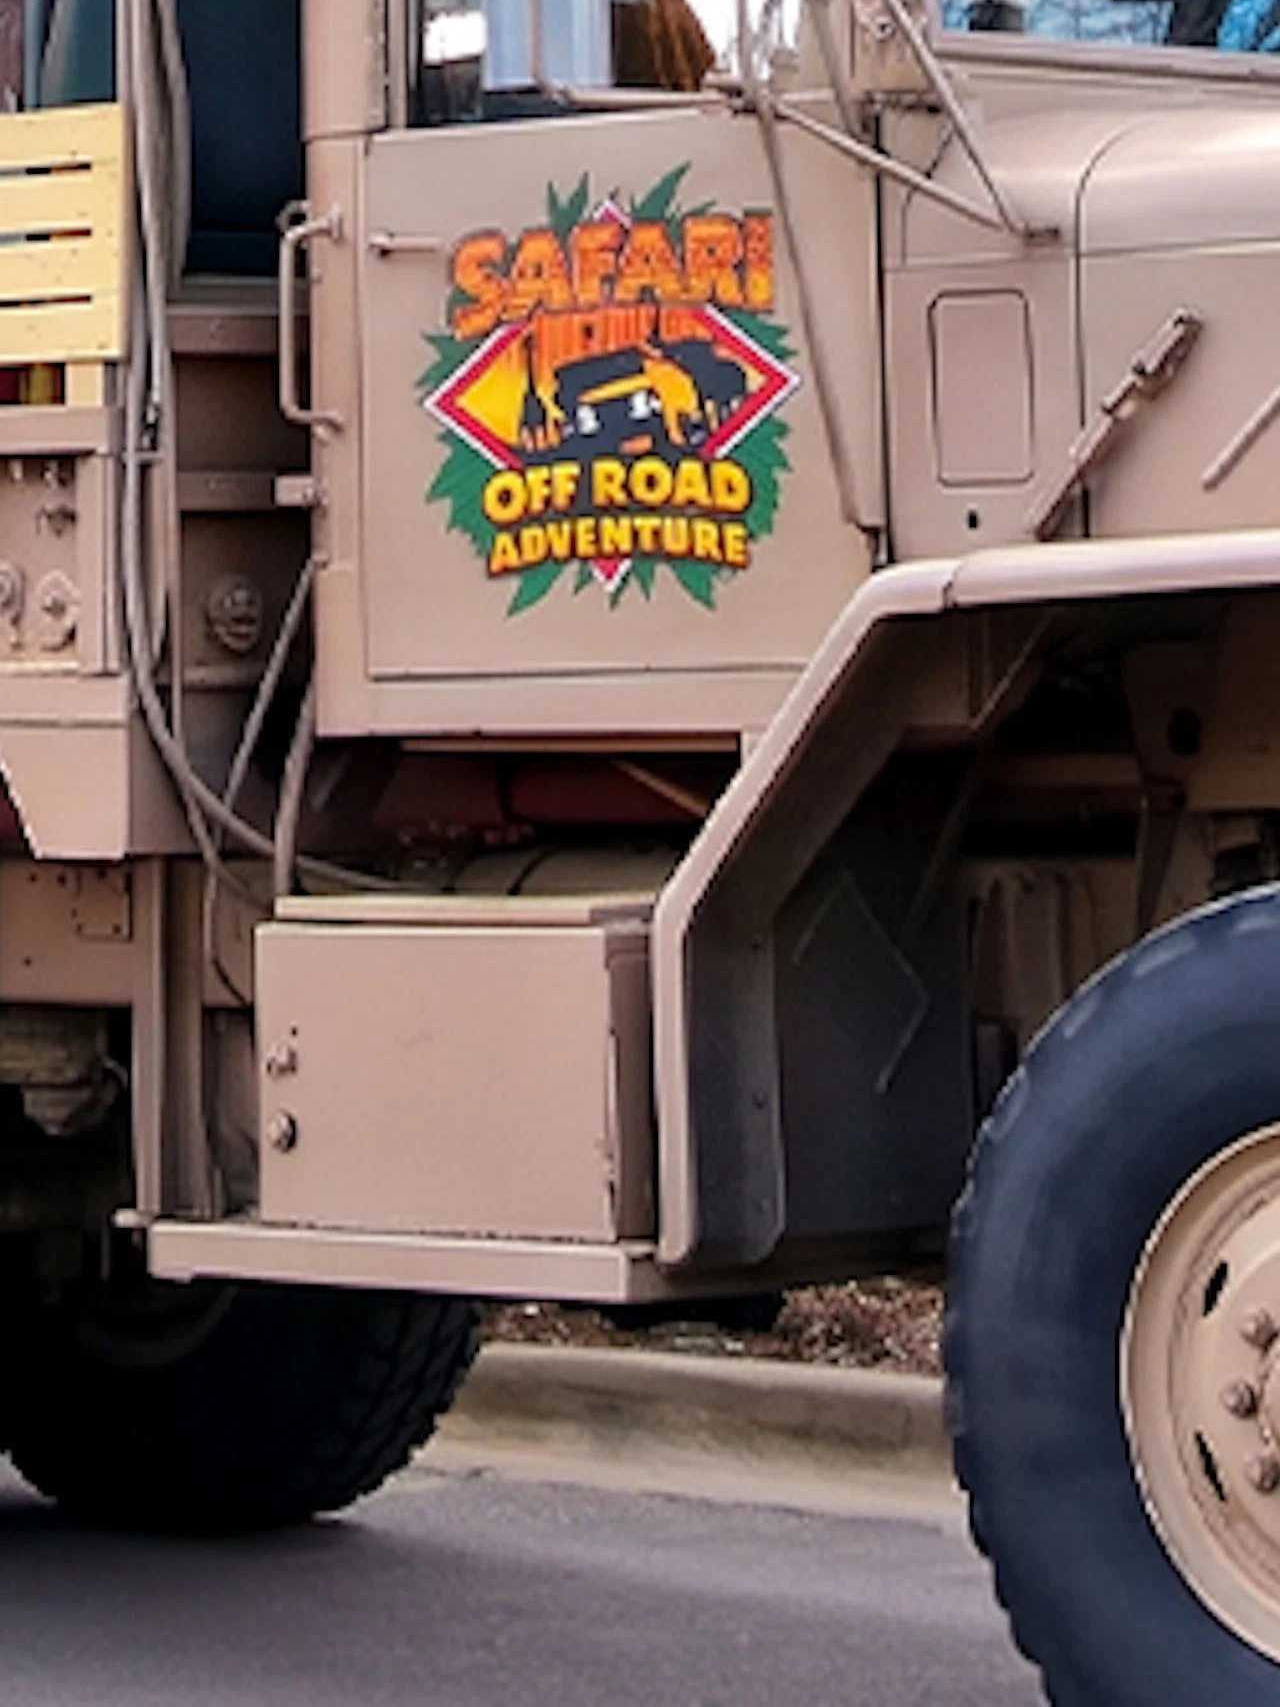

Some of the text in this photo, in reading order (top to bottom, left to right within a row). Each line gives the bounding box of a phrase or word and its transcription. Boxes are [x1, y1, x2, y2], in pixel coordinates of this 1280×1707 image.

[453, 209, 773, 340] SAFARI
[482, 457, 751, 523] OFF ROAD
[488, 517, 749, 576] ADVENTURE
